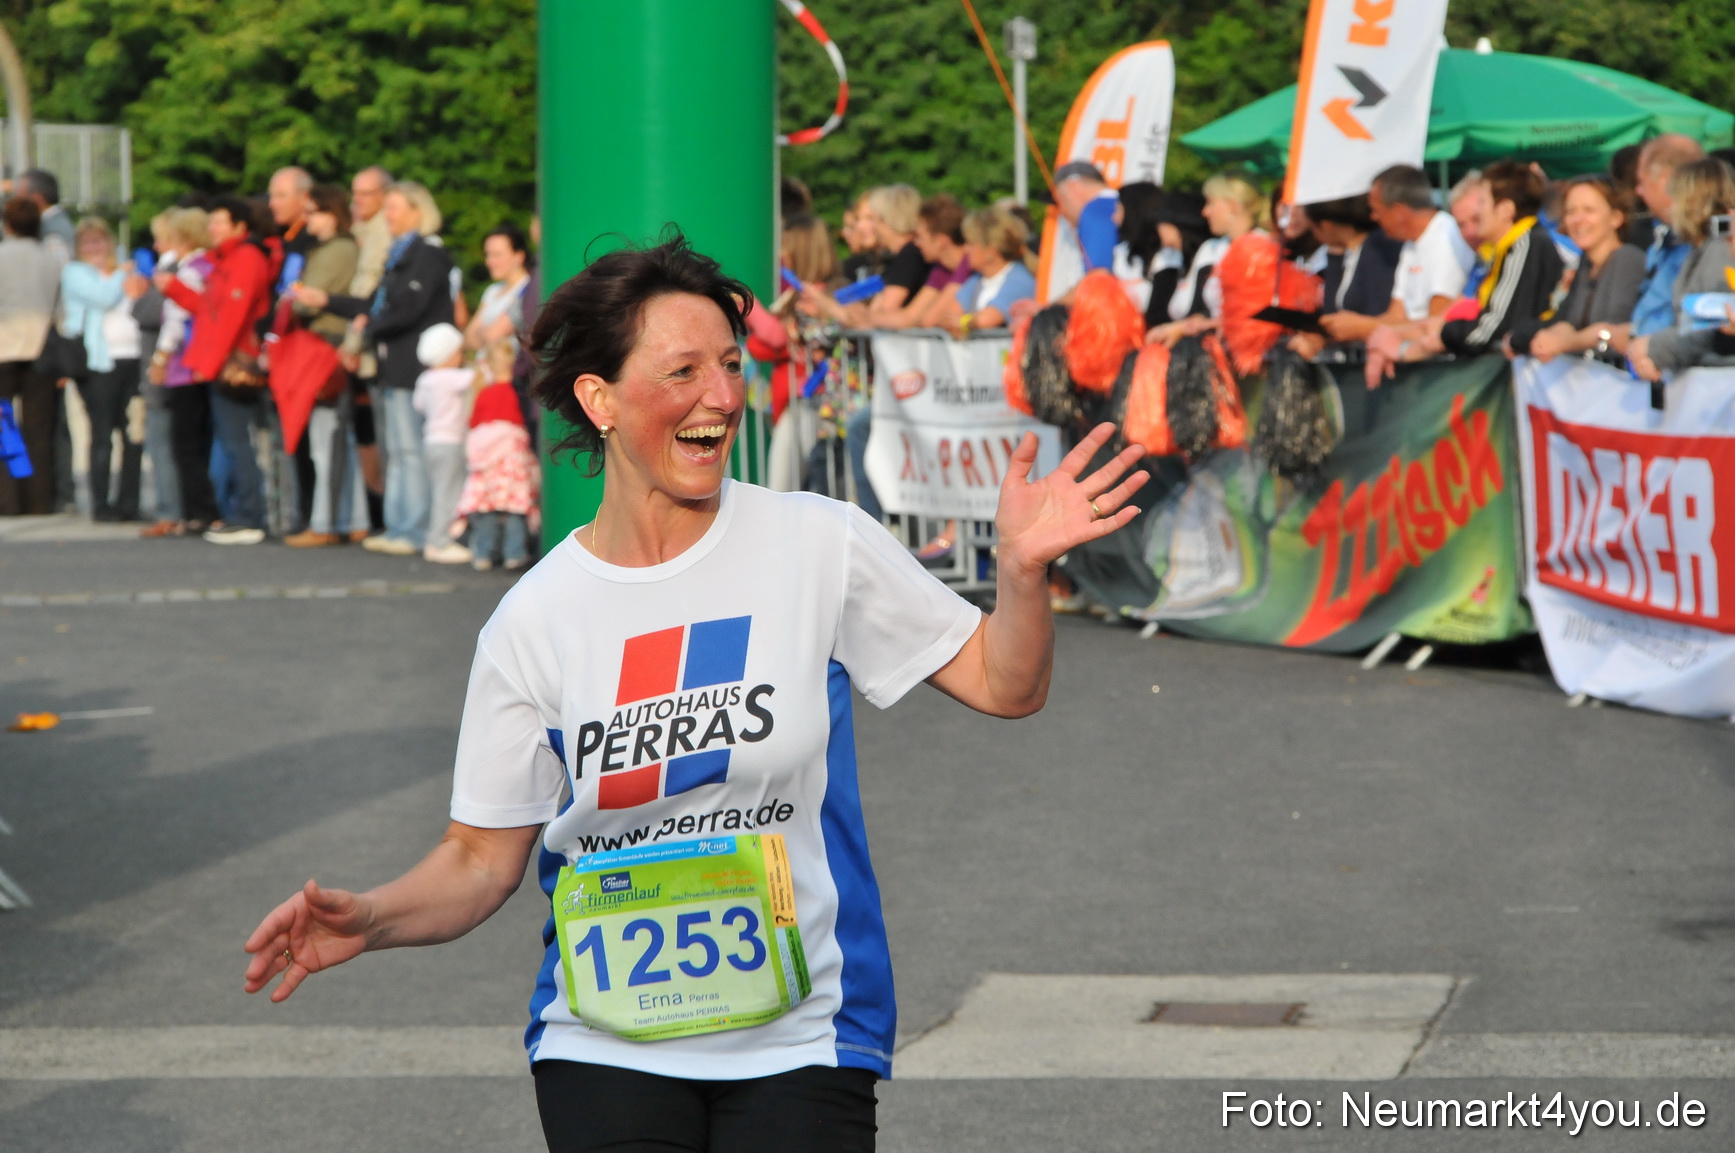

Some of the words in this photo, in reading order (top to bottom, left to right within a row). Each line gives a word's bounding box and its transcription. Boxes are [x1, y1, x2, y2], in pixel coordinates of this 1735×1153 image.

[1546, 431, 1719, 618] MEIER
[576, 684, 775, 780] PERRAS
[607, 686, 741, 733] AUTOHAUS
[577, 798, 794, 853] wwwperras.de
[588, 883, 661, 907] firmenlauf
[575, 906, 767, 992] 1253
[633, 1016, 655, 1026] Team
[657, 1011, 694, 1024] Autohaus
[696, 1005, 730, 1016] PERRAS
[638, 992, 683, 1010] Erna
[689, 991, 720, 1003] Perras
